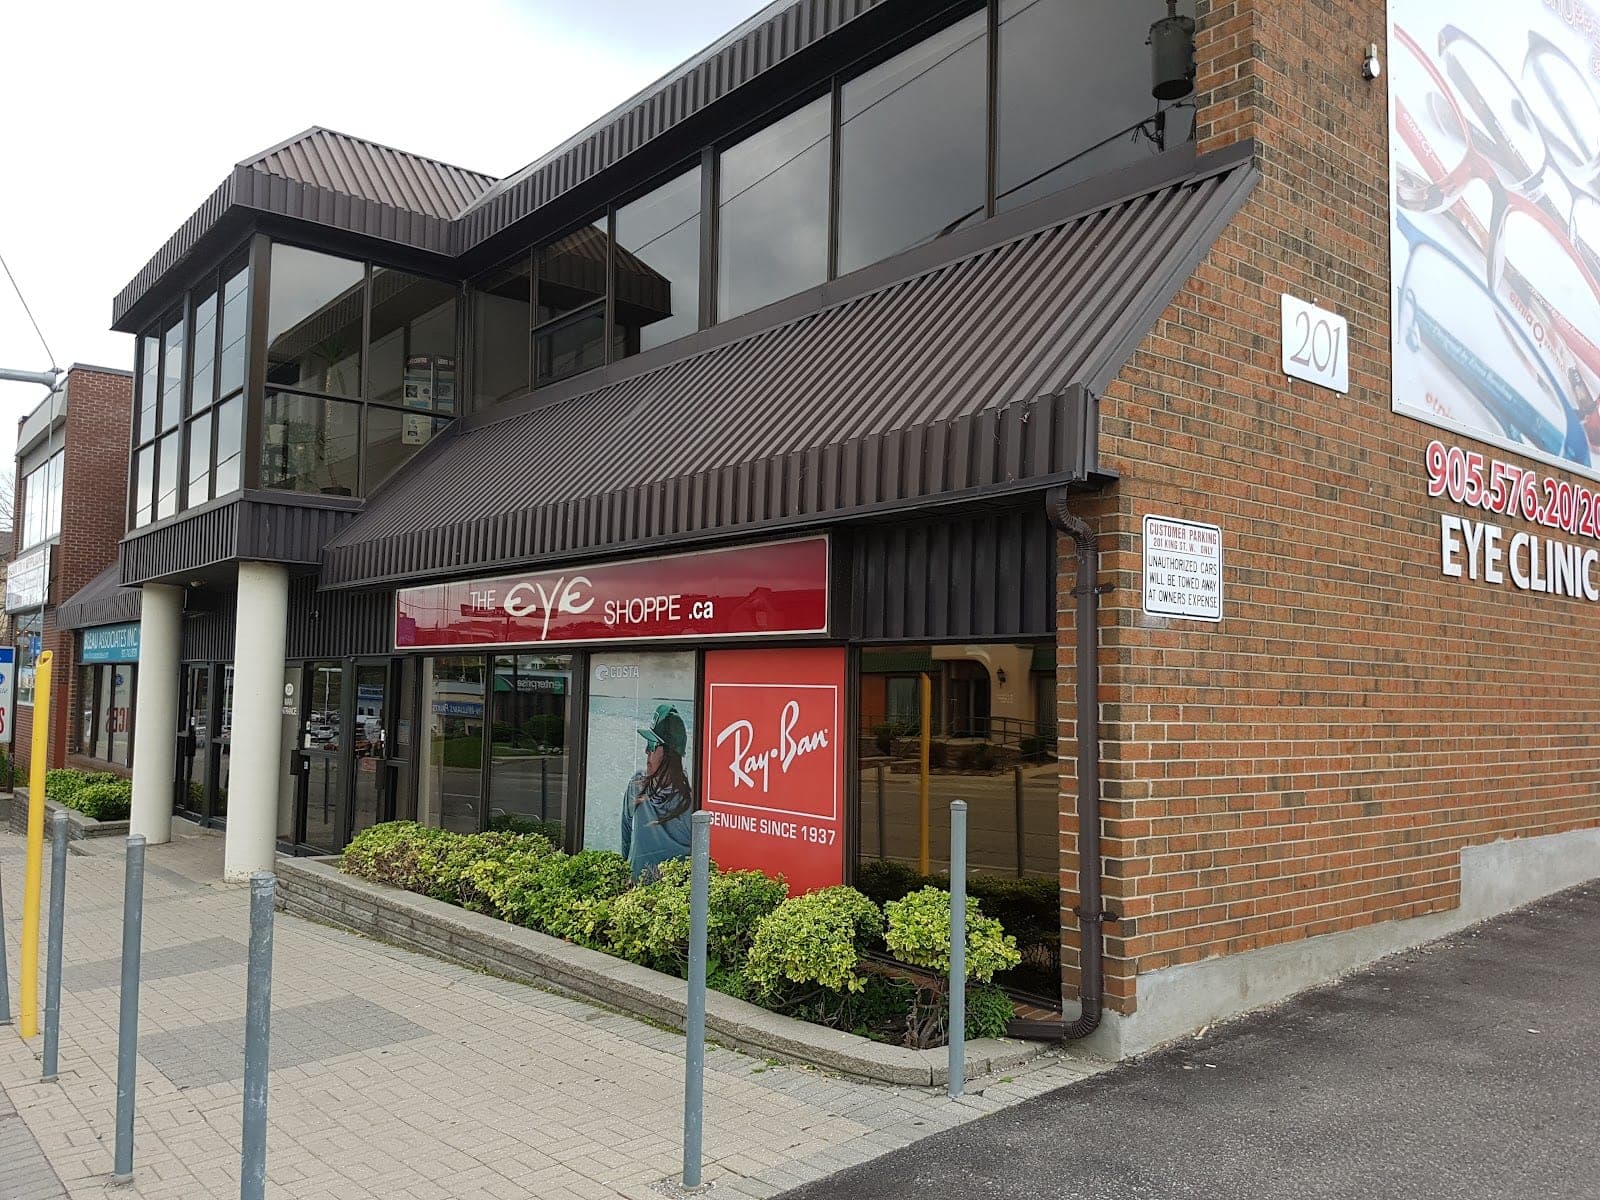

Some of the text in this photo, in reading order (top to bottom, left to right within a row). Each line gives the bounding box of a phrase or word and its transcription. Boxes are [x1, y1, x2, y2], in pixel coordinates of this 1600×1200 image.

[1290, 311, 1341, 378] 201
[1149, 522, 1217, 545] CUSTOMER PARKING
[1153, 537, 1163, 547] 201
[1164, 539, 1178, 550] KING
[1200, 544, 1214, 556] ONLY
[1441, 514, 1599, 602] EYE CLINIC
[1148, 554, 1218, 576] UNAUTHORIZED CARS
[1149, 572, 1217, 593] WILL BE TOWED AWAY
[470, 589, 496, 612] THE
[603, 594, 714, 625] SHOPPE .ca
[1148, 588, 1218, 609] AT OWNERS EXPENSE
[610, 665, 640, 678] COSTA
[709, 811, 836, 846] GENUINE SINCE 1937
